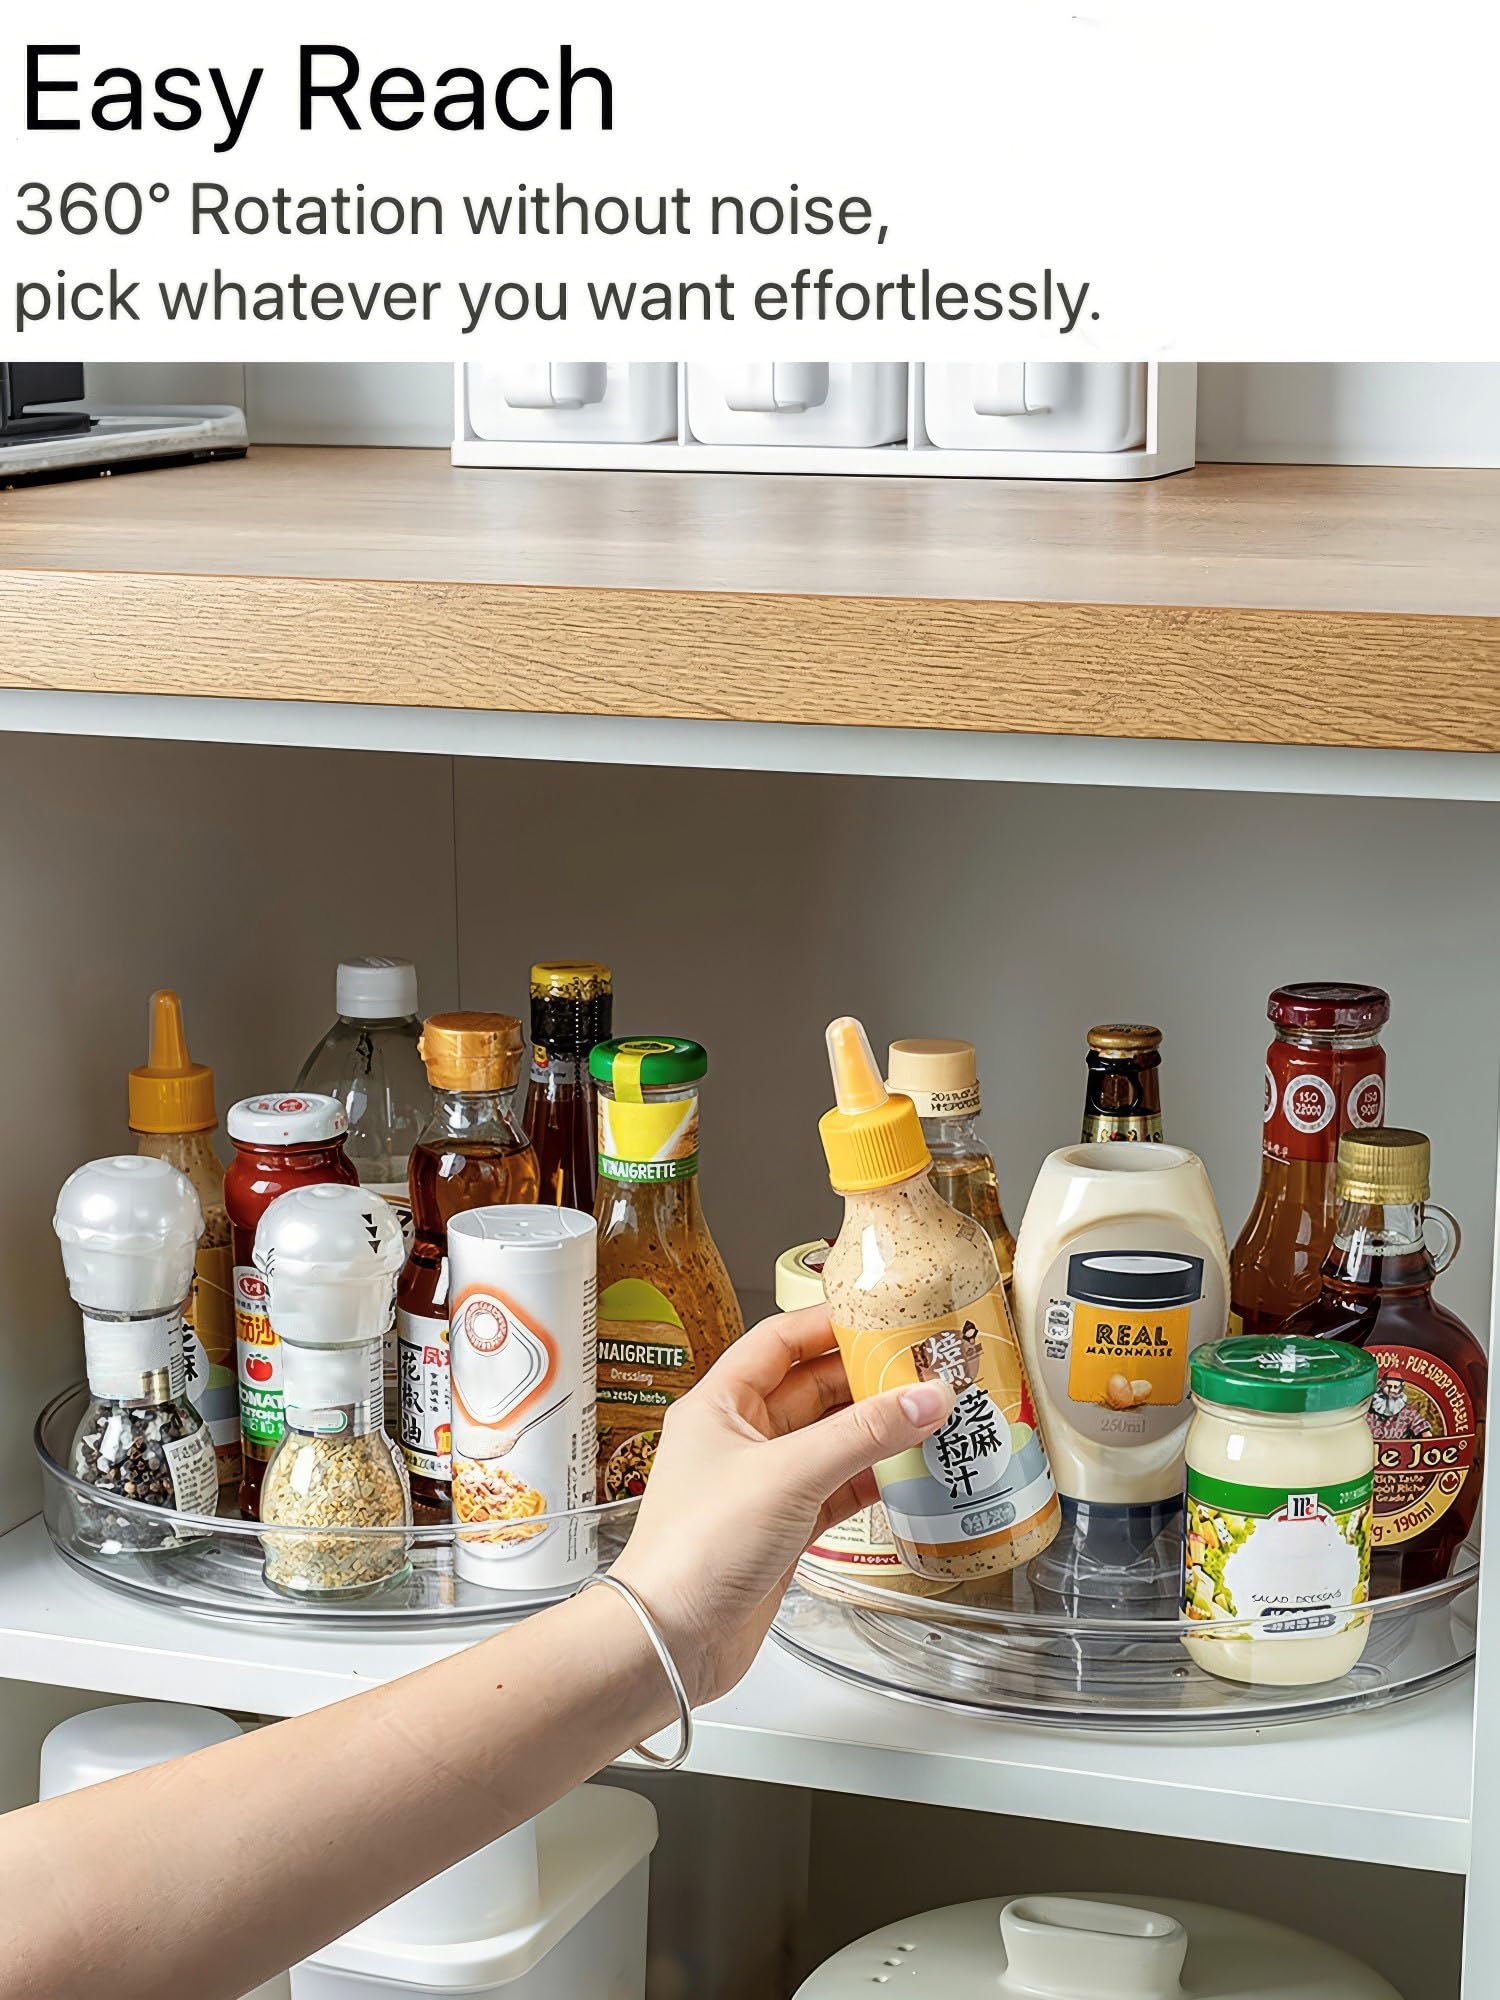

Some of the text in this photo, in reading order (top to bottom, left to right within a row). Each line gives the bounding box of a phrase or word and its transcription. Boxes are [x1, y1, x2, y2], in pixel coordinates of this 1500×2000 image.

[1096, 1323, 1169, 1347] REAL
[1086, 1346, 1173, 1357] MAYONNAISE
[1407, 1443, 1459, 1469] Joe
[1393, 1501, 1435, 1533] 190ml
